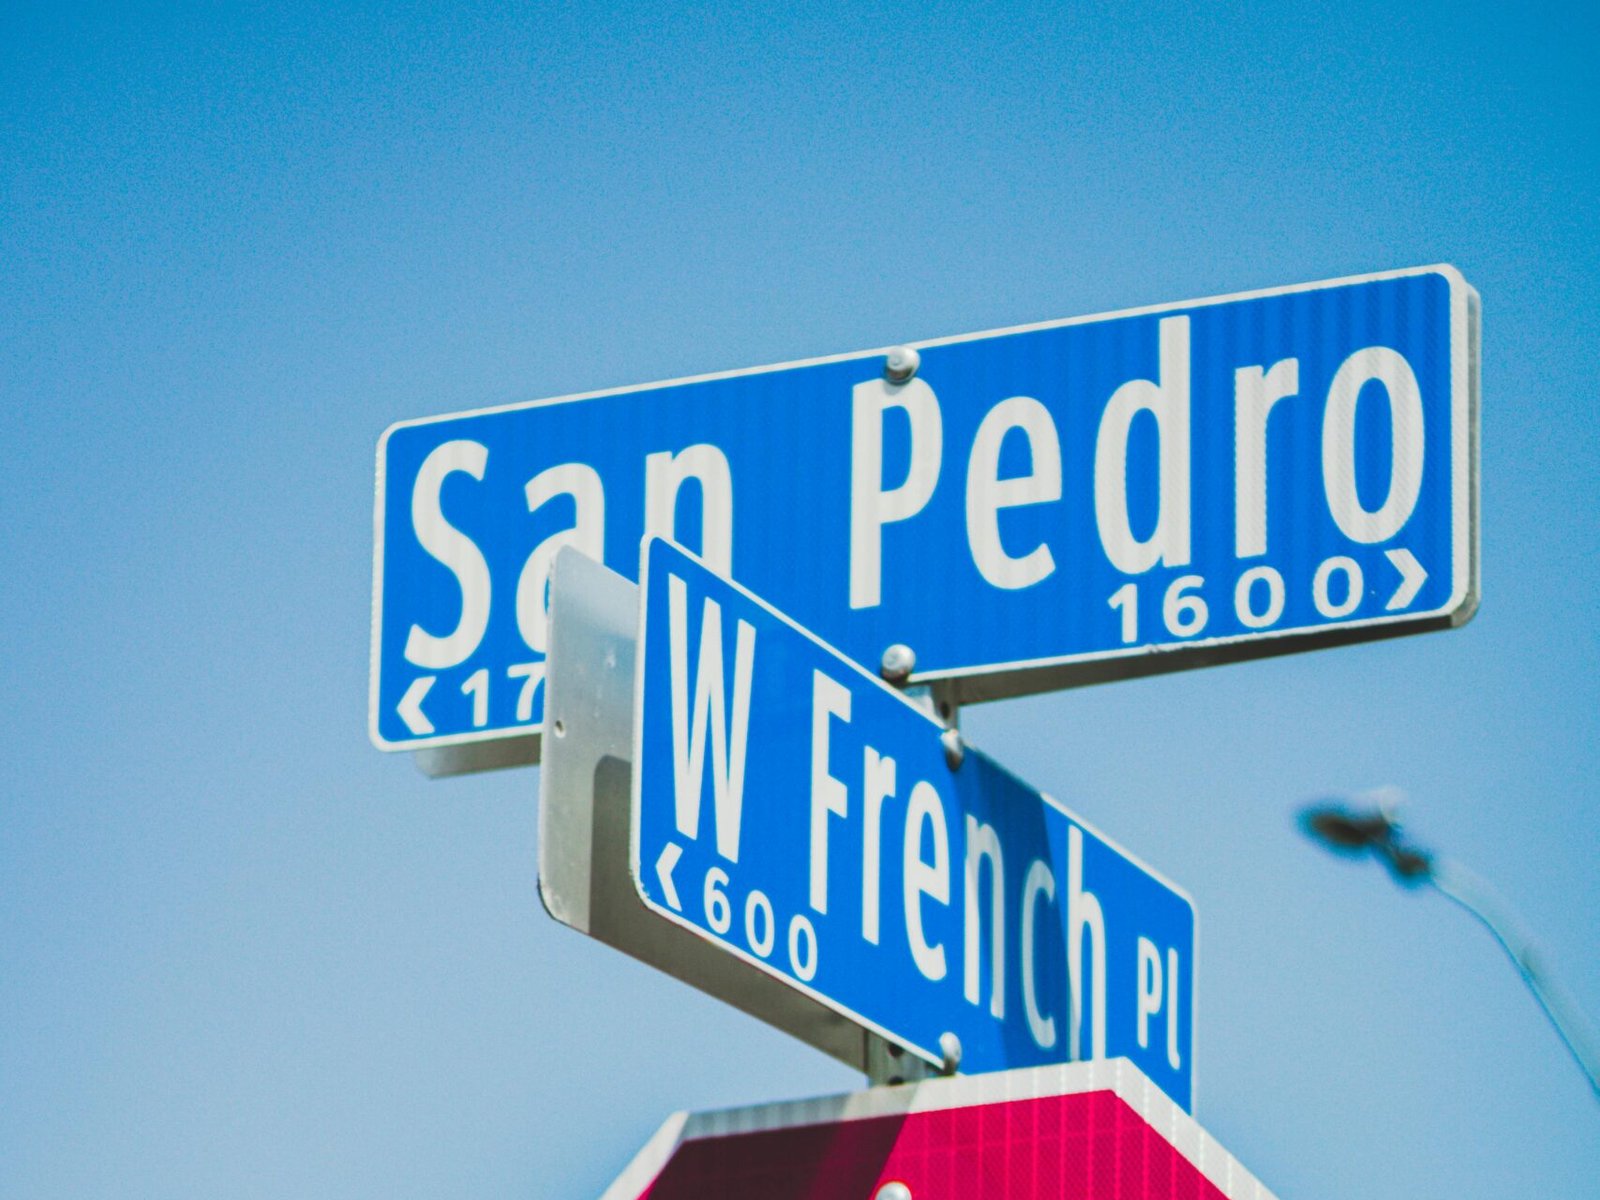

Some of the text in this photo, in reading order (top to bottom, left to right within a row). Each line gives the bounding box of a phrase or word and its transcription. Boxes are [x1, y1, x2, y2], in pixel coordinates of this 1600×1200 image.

[404, 315, 1425, 669] San Pedro
[1107, 556, 1364, 644] 1600
[668, 572, 1181, 1071] W French Pl
[703, 866, 819, 982] 600
